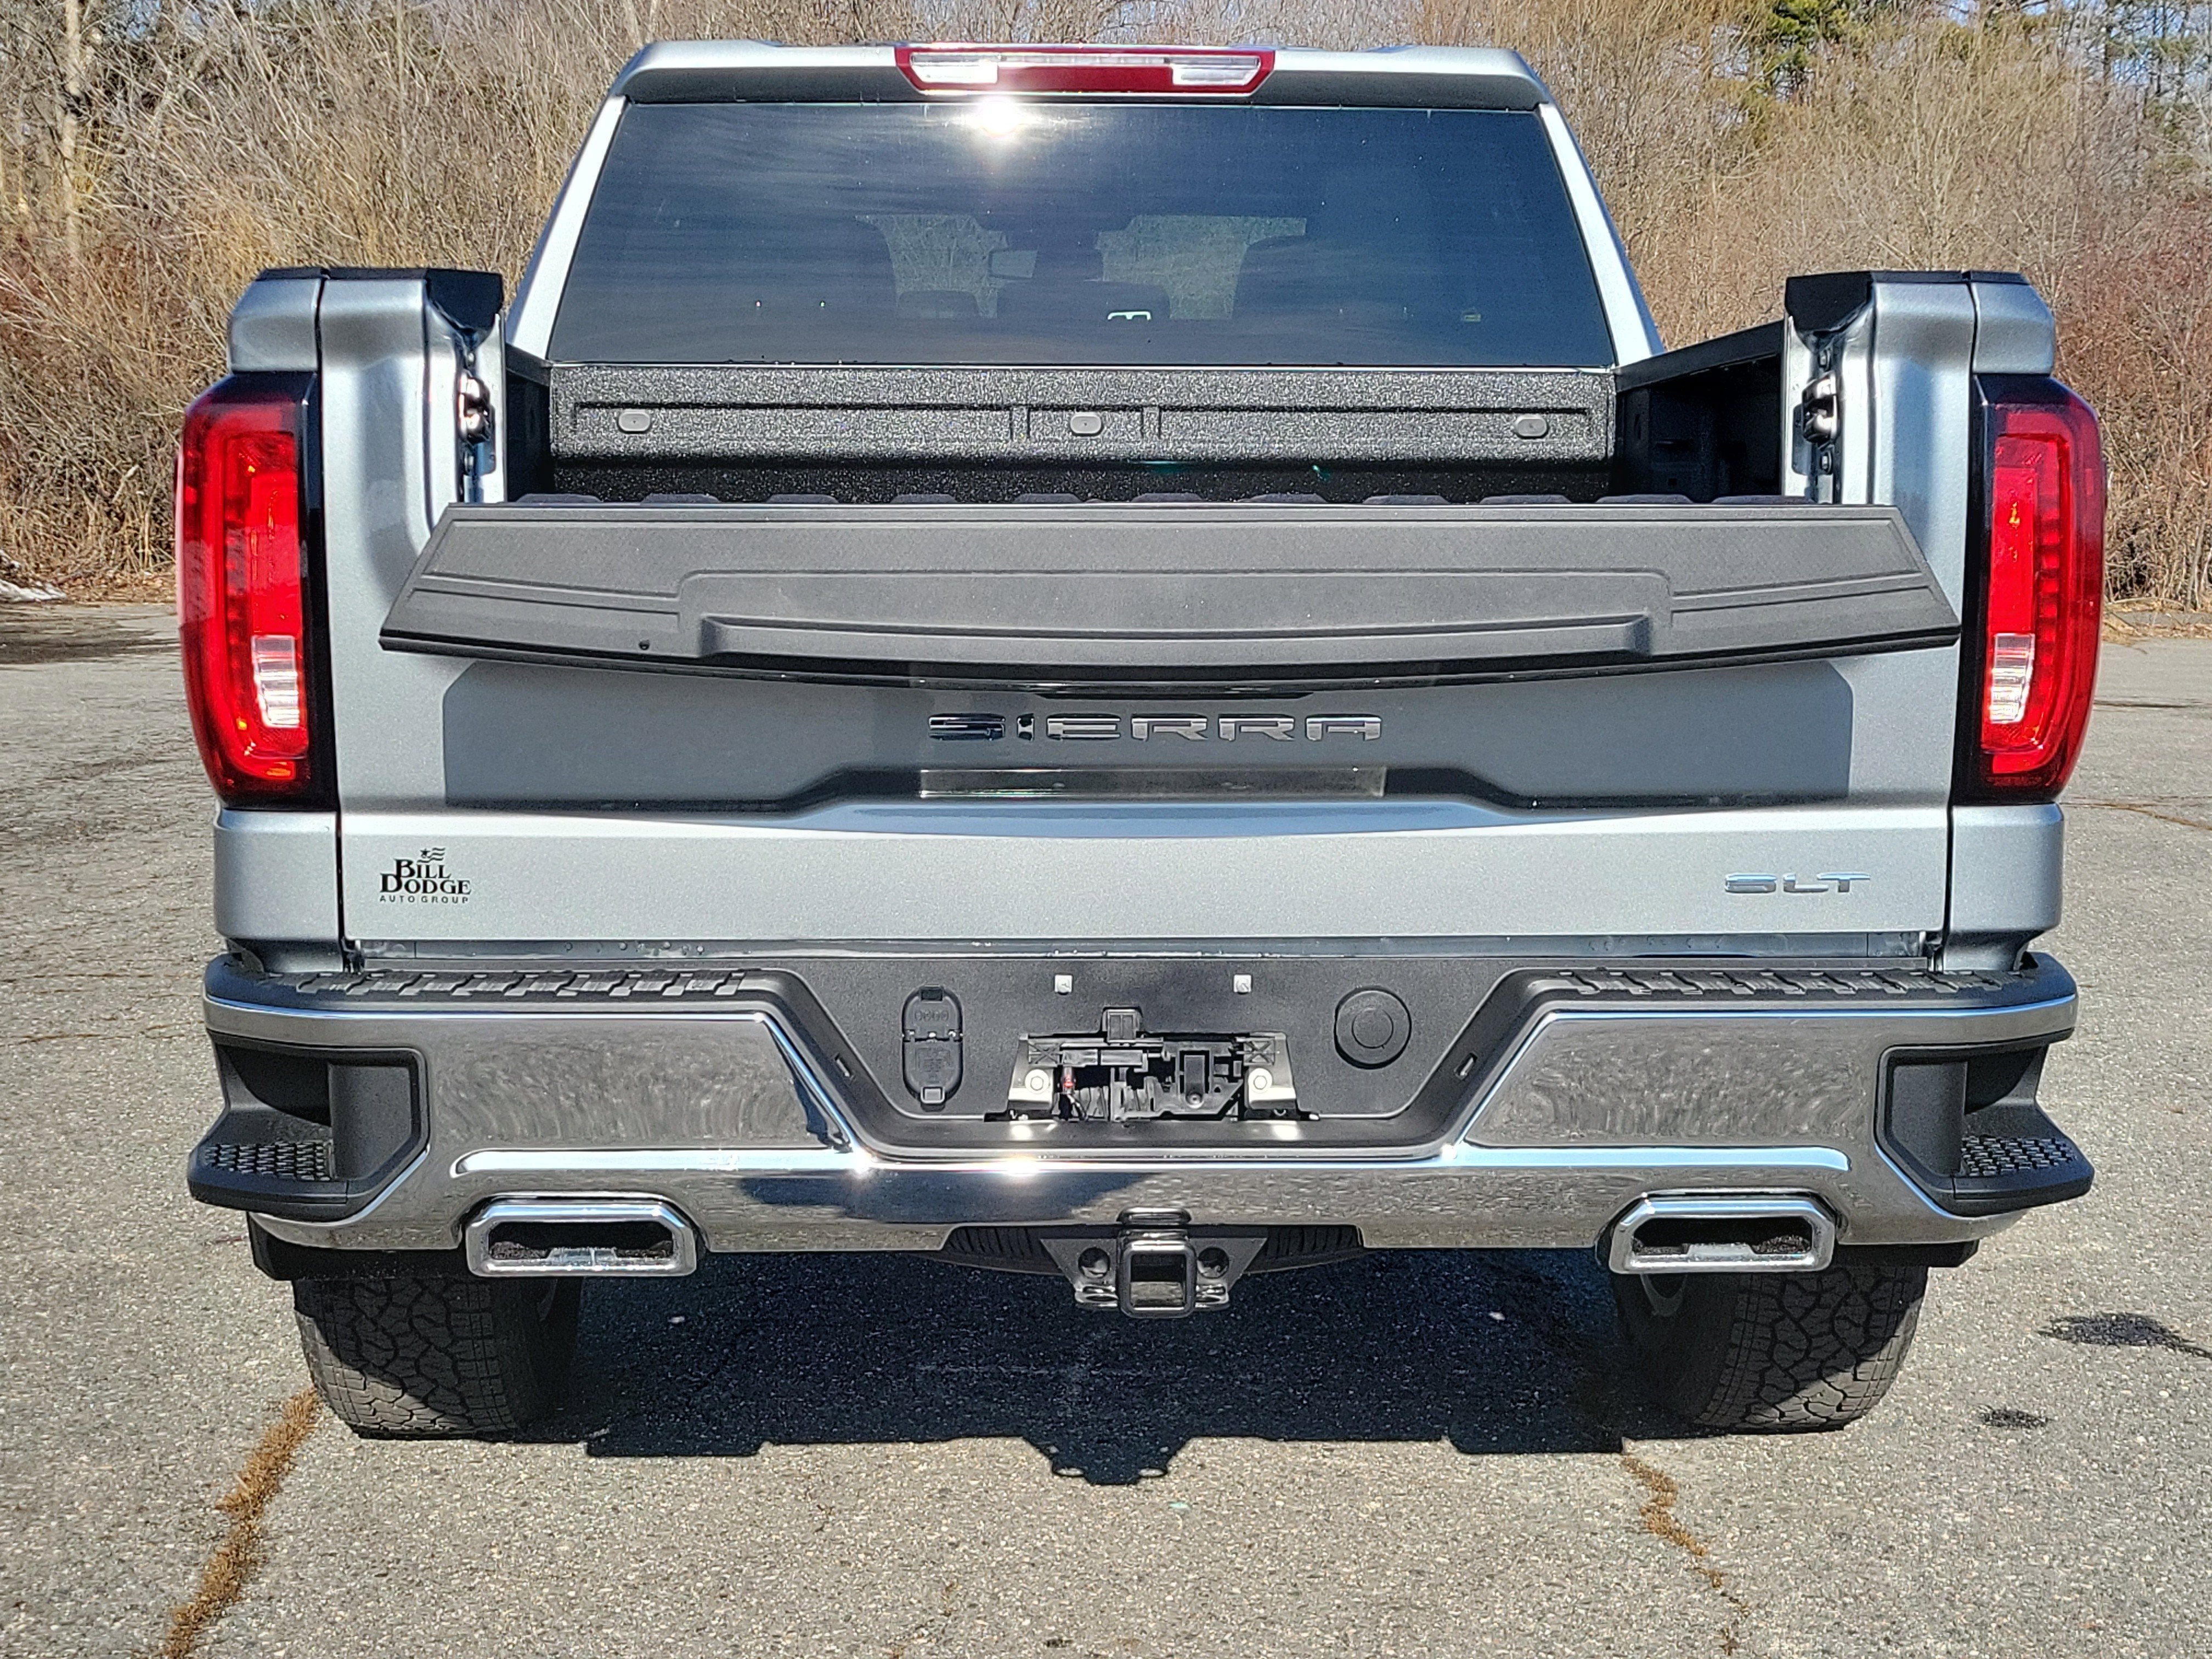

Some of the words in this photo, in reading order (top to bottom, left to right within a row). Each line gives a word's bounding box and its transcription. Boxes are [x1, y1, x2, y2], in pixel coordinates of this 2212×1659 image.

[928, 713, 1383, 741] SIERRA
[394, 858, 452, 878] BILL
[380, 873, 471, 895] DODGE
[1724, 871, 1871, 893] SLT
[380, 895, 415, 903] AUTO
[421, 895, 469, 904] GROUP
